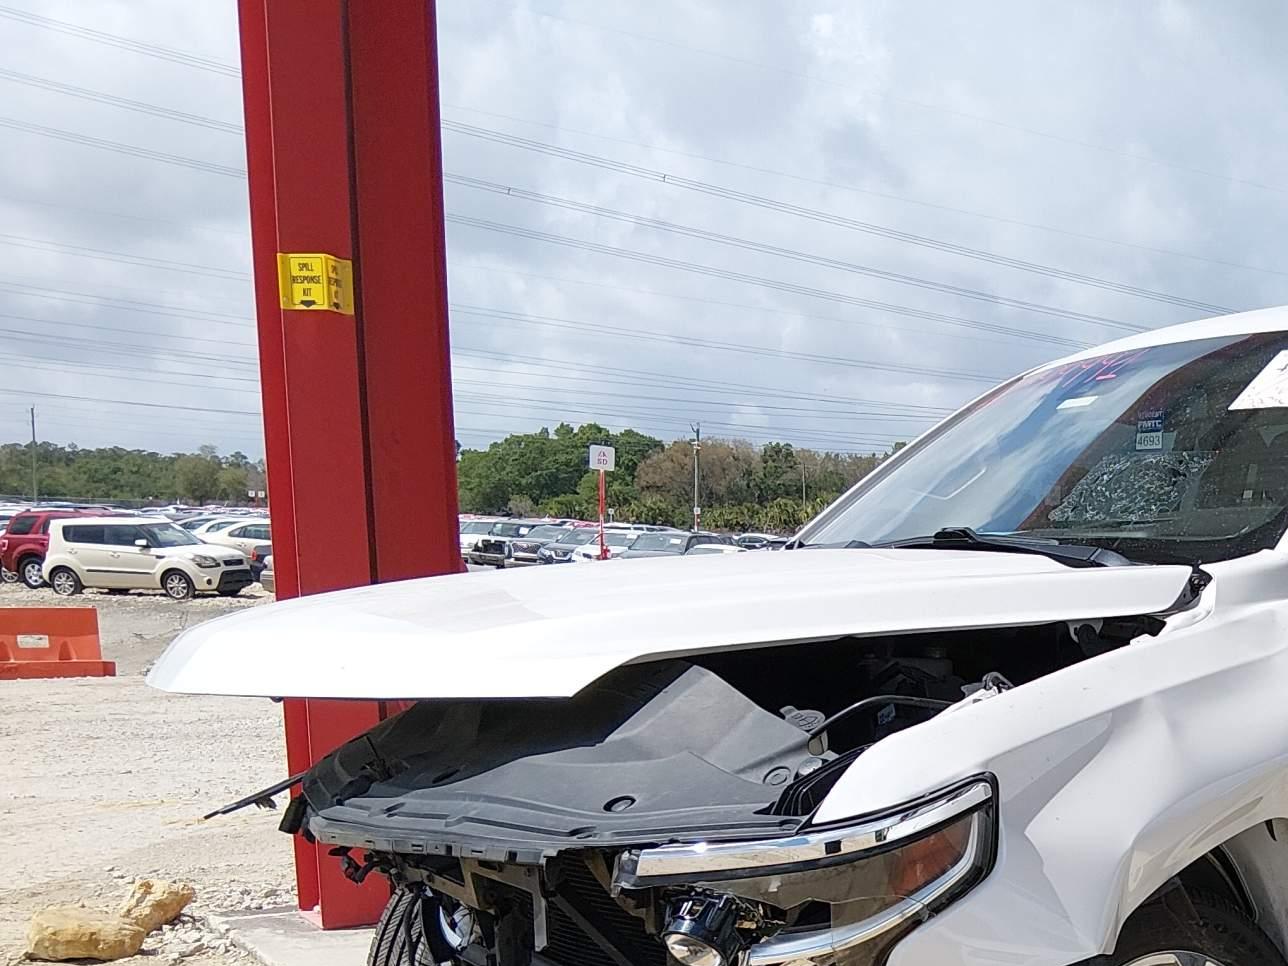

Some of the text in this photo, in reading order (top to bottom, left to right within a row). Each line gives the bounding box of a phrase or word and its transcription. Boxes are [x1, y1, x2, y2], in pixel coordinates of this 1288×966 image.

[297, 262, 314, 272] SPILL
[291, 275, 322, 284] RESPONSE
[302, 287, 312, 297] KIT
[1137, 435, 1161, 447] 4693
